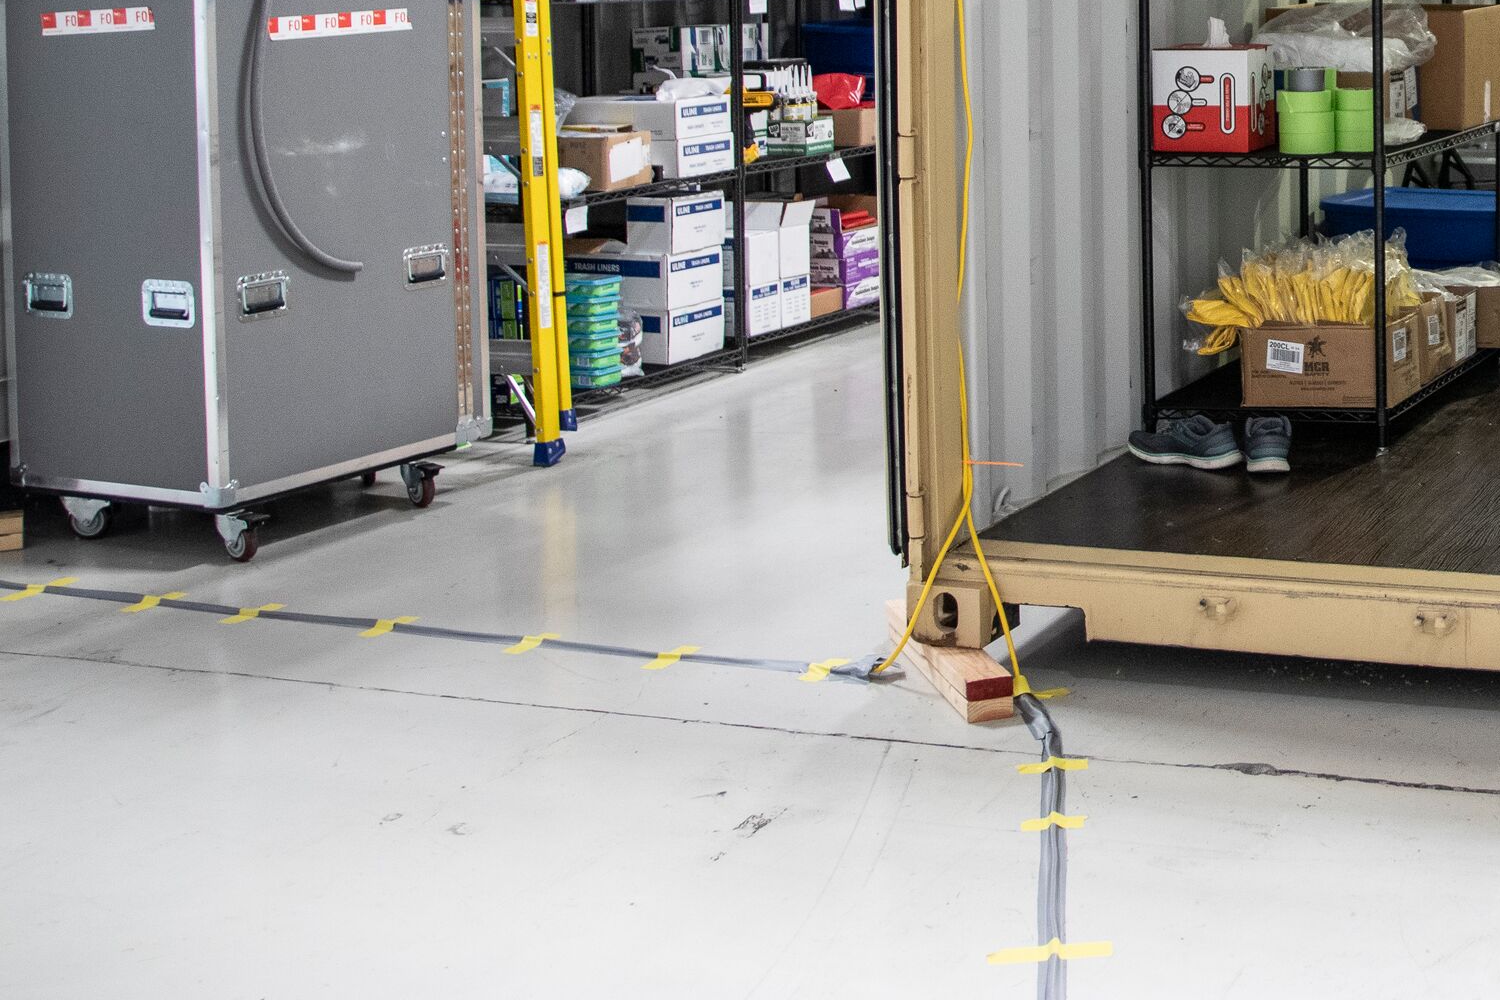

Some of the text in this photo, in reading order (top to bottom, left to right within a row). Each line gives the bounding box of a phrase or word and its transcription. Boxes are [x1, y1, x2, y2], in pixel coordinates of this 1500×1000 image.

[683, 107, 697, 116] ULINE
[685, 145, 700, 155] ULINE
[677, 206, 690, 215] ULINE
[574, 262, 595, 271] TRASH
[597, 264, 620, 272] LINERS
[671, 260, 686, 271] ULINE
[674, 314, 688, 325] ULINE
[1270, 341, 1290, 350] 200CL
[1304, 362, 1329, 371] MCR
